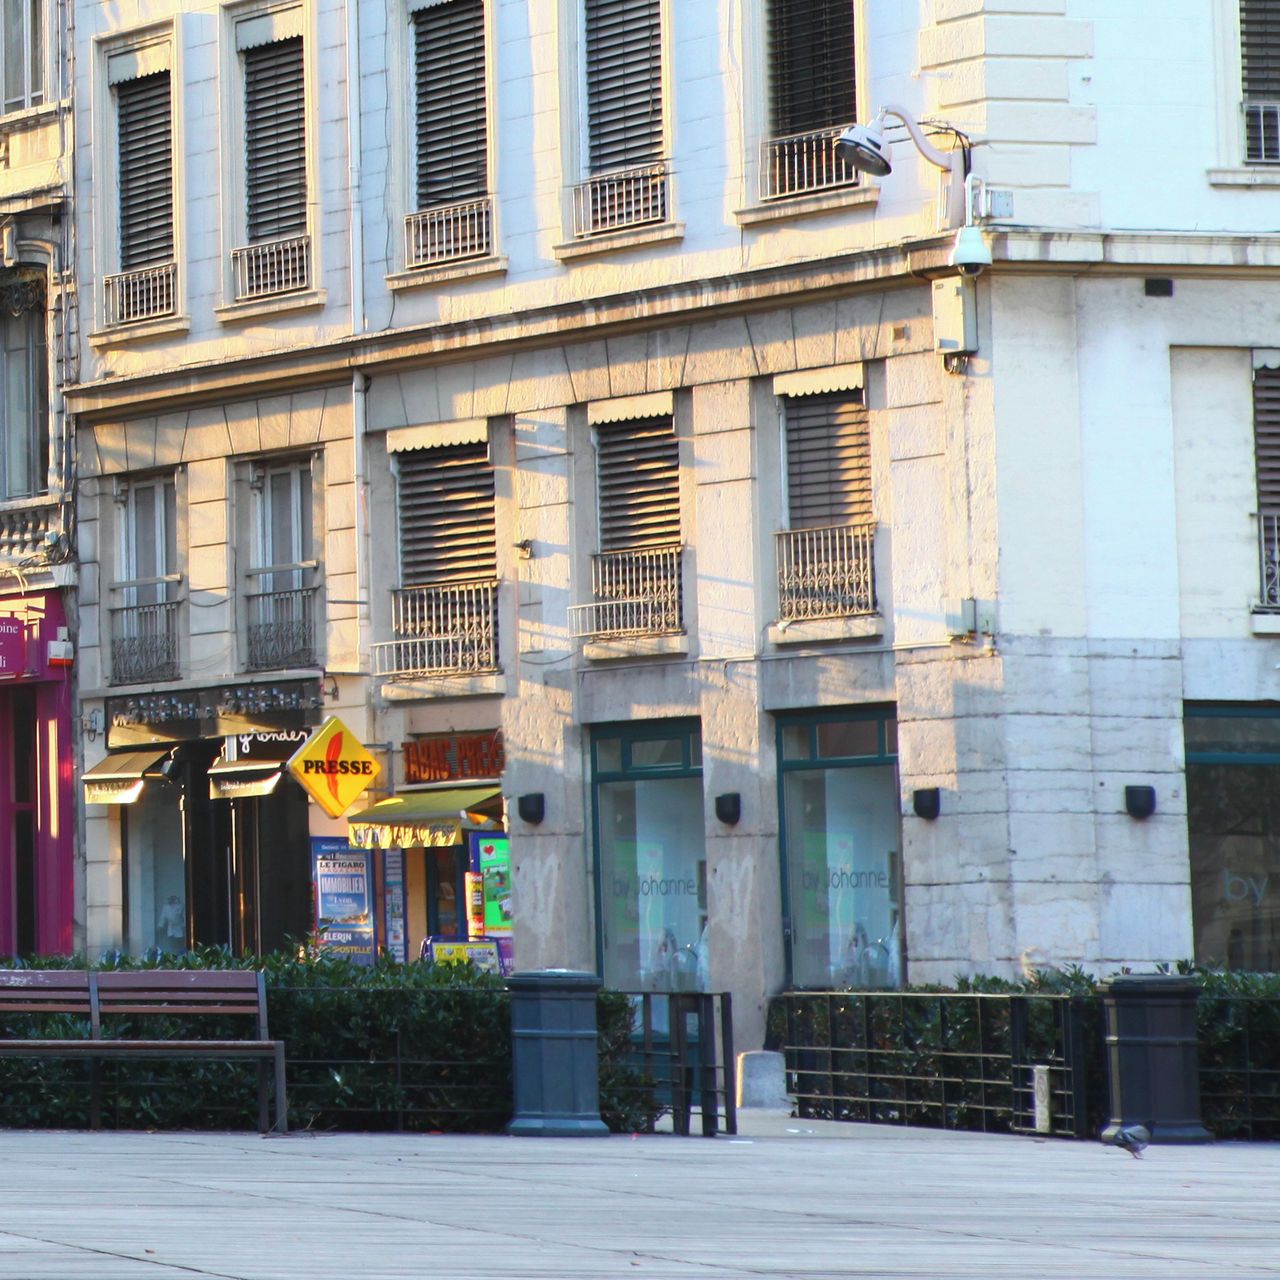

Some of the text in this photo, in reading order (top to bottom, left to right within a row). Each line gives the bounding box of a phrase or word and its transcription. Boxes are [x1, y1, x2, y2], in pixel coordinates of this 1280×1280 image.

[303, 760, 372, 774] PRESSE
[322, 877, 364, 893] IMMOBILIER
[1223, 869, 1268, 907] by
